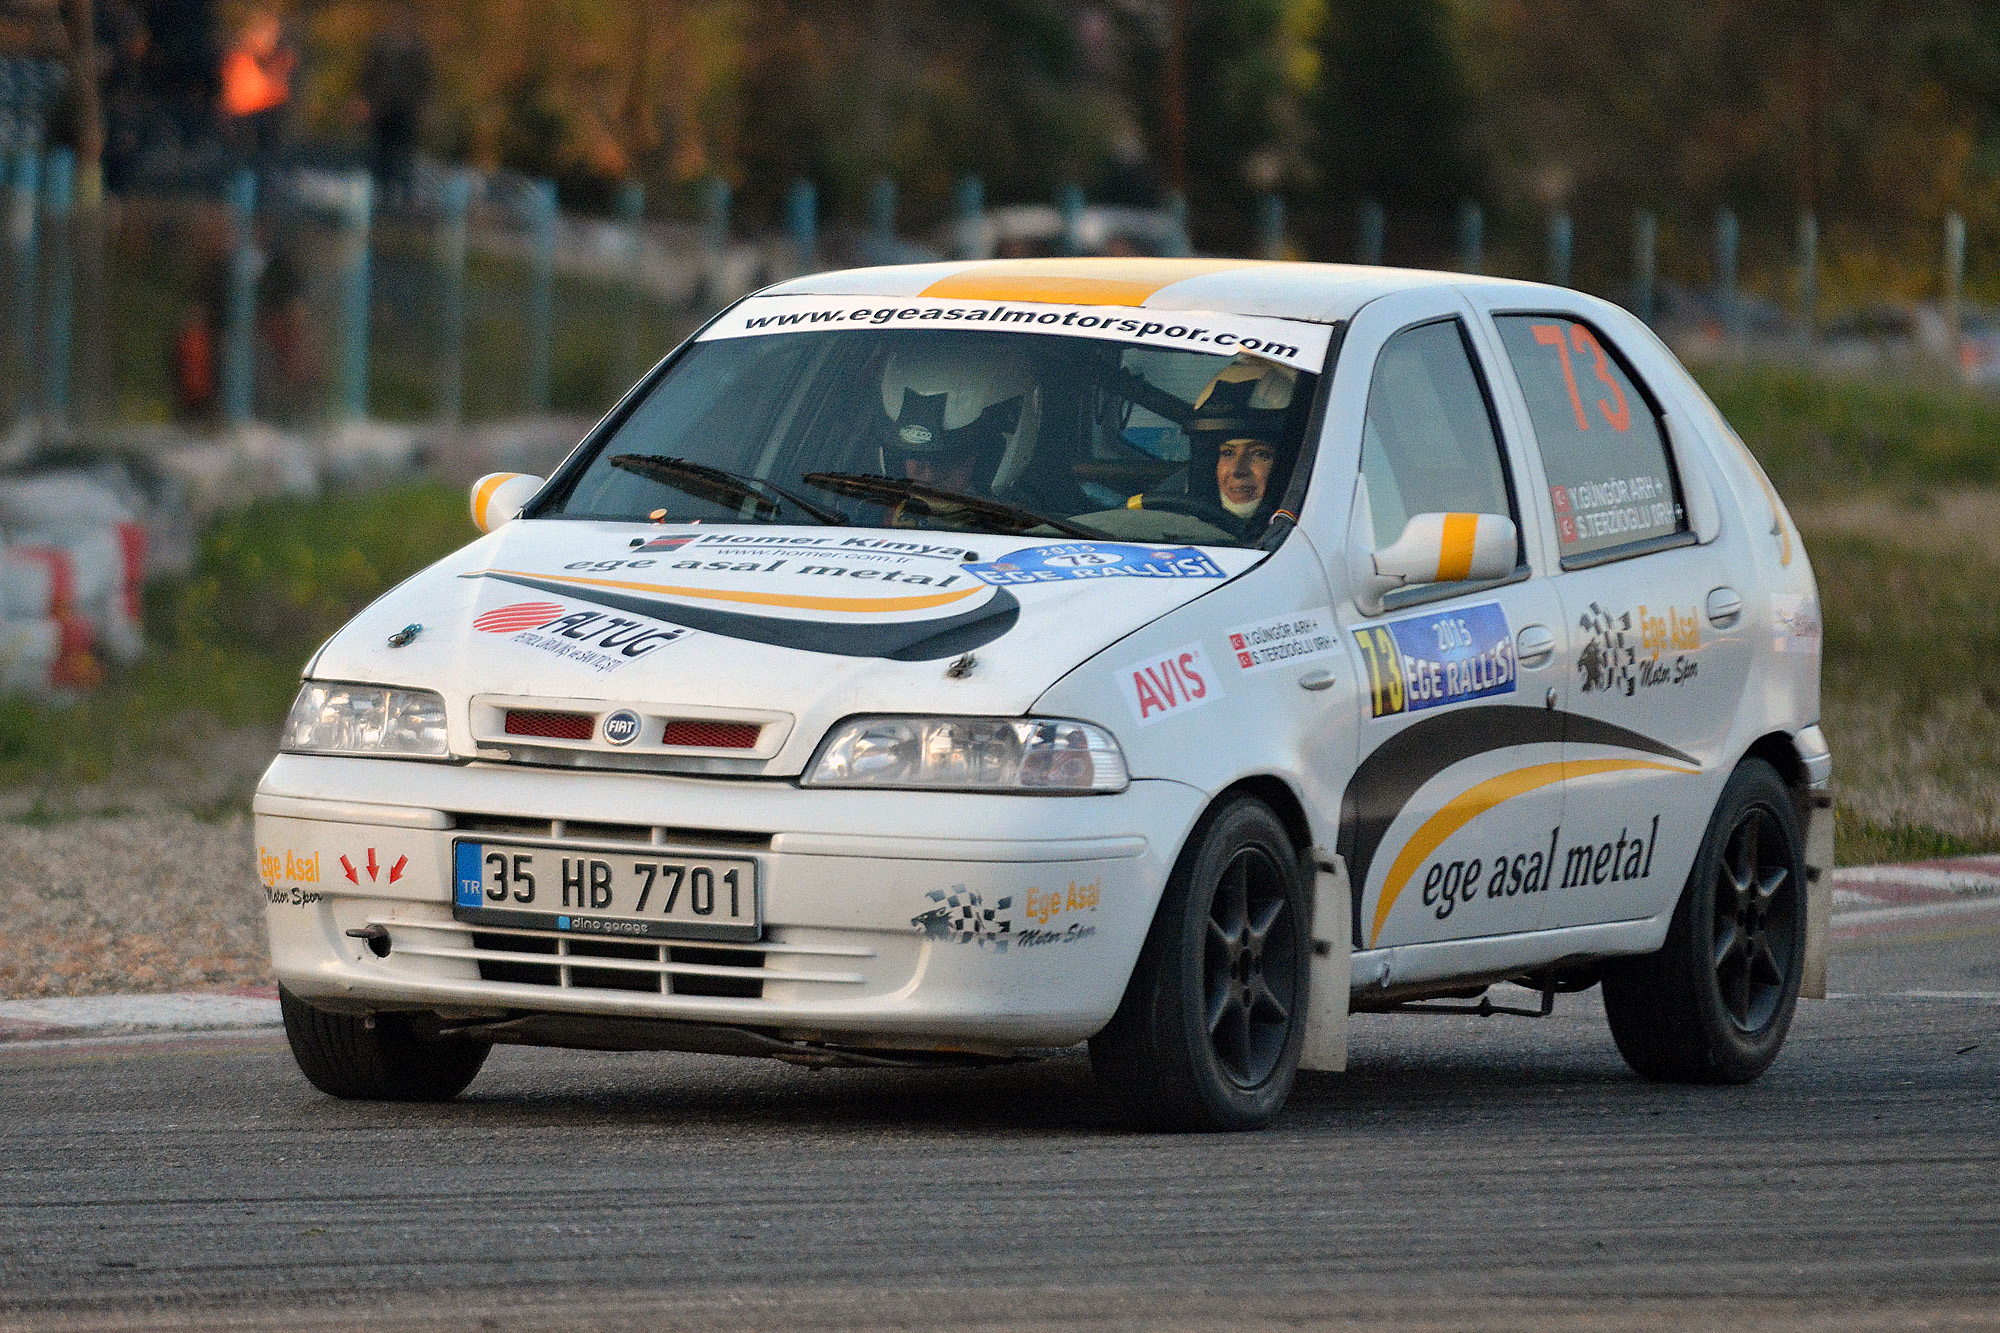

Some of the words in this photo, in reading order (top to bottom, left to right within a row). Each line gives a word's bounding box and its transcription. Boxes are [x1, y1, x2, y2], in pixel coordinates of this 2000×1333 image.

[745, 305, 1300, 360] www.egeasalmotorspor.com
[1530, 323, 1631, 432] 73
[700, 534, 834, 545] Homer
[839, 537, 967, 555] Kimya
[718, 548, 914, 564] www.homer.com.tr
[1058, 553, 1107, 566] 73
[564, 559, 657, 572] ege
[671, 559, 787, 572] asal
[797, 564, 961, 588] metal
[974, 570, 1064, 583] EGE
[537, 611, 686, 658] ALTUĞ
[1432, 618, 1473, 651] 2015
[1637, 604, 1667, 662] Ege
[1669, 604, 1700, 650] Asal
[1132, 653, 1207, 719] AVIS
[1354, 627, 1405, 717] 73
[1404, 653, 1443, 701] EGE
[1639, 659, 1671, 688] Motor
[1673, 654, 1699, 687] Spor
[608, 720, 635, 734] FIAT
[260, 846, 282, 887] Ege
[286, 849, 320, 883] Asal
[1422, 857, 1483, 921] ege
[1487, 825, 1562, 899] asal
[1560, 814, 1661, 890] metal
[263, 884, 290, 904] Motor
[291, 887, 323, 909] Spor
[462, 879, 481, 895] TR
[485, 852, 536, 903] 35
[562, 857, 614, 908] HB
[634, 861, 740, 917] 7701
[1025, 886, 1062, 925] Ege
[1066, 875, 1101, 912] Asal
[571, 917, 601, 929] dino
[603, 921, 649, 934] garage
[1017, 928, 1060, 948] Motor
[1062, 923, 1097, 944] Spor
